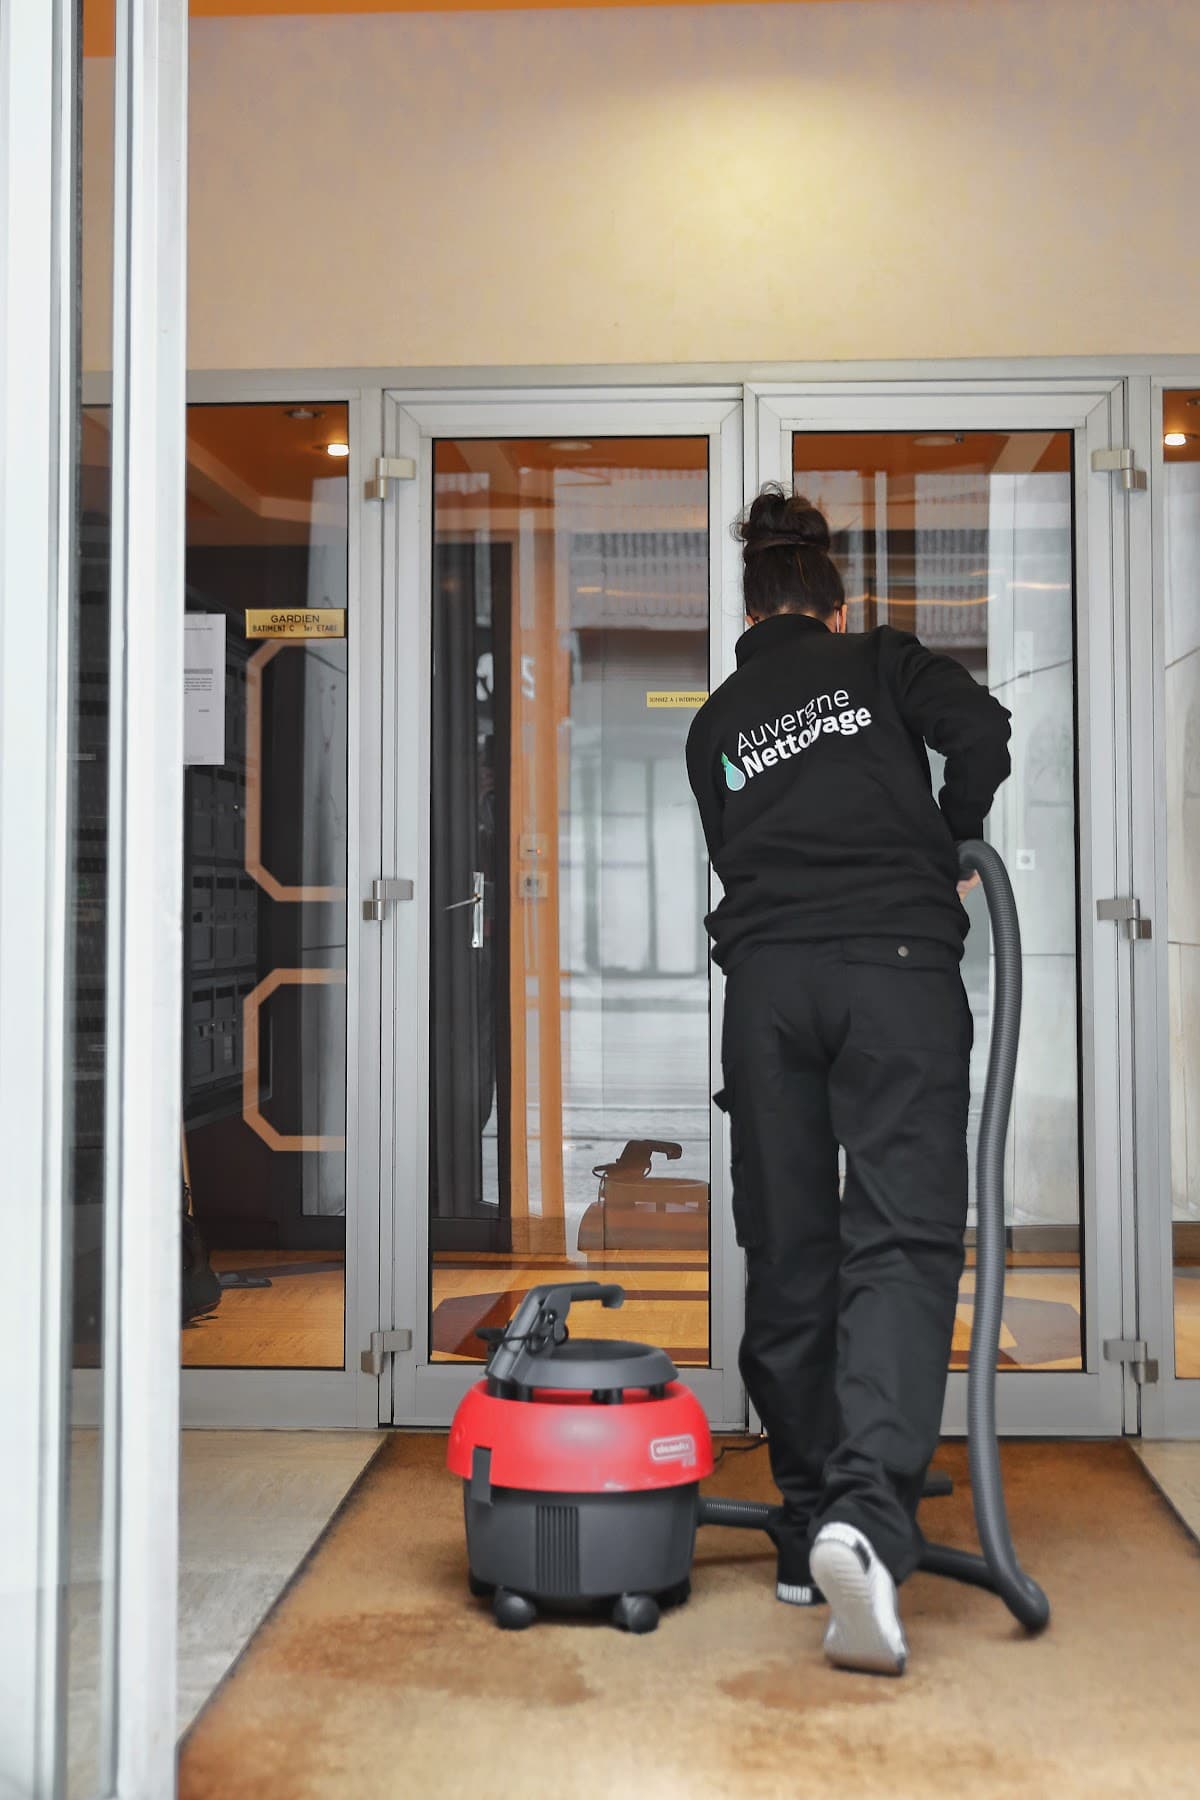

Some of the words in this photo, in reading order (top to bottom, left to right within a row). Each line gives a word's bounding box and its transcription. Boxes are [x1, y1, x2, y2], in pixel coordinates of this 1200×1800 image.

[252, 624, 286, 632] BATIMENT
[288, 624, 295, 632] C
[270, 614, 320, 623] GARDIEN
[737, 689, 849, 757] Auvergne
[741, 707, 872, 779] Nettoyage
